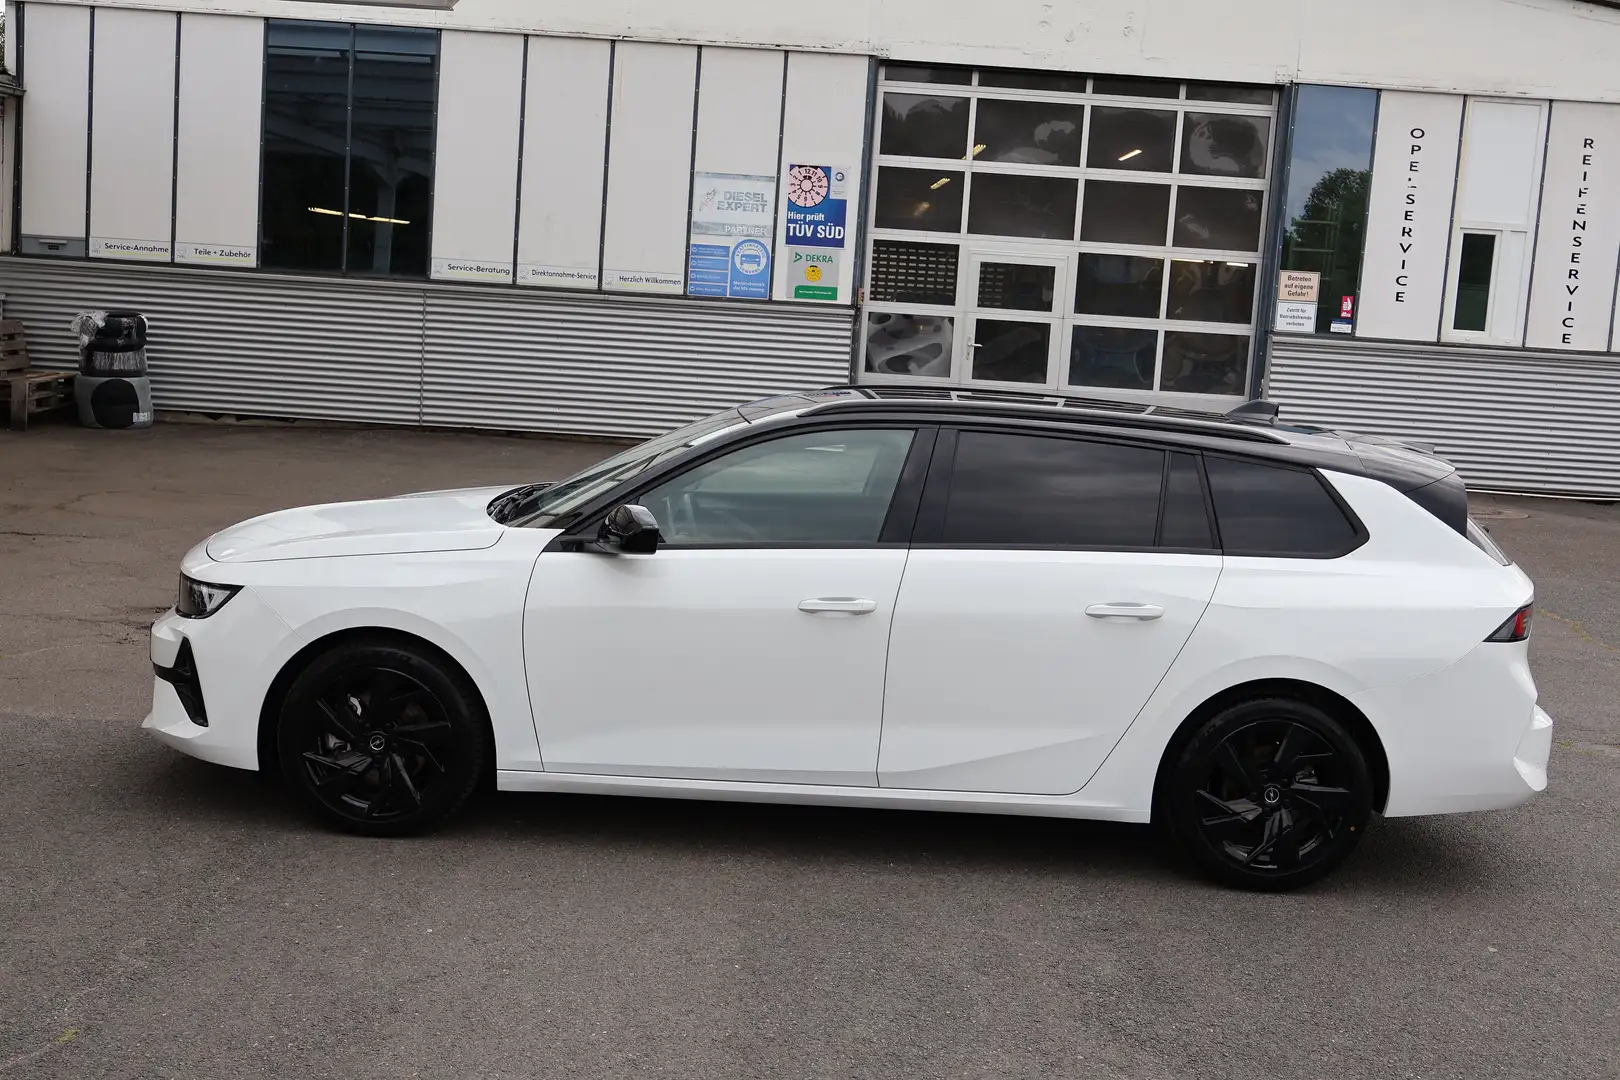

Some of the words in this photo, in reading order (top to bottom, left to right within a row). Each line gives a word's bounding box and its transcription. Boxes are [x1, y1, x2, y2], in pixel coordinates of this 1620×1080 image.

[724, 191, 768, 203] DIESEL
[716, 201, 768, 212] EXPERT
[788, 211, 804, 220] Hier
[806, 213, 824, 222] prüft
[725, 225, 766, 235] PARTNER
[788, 221, 814, 237] TÜV
[817, 223, 844, 239] SÜD
[1562, 138, 1594, 344] REIFENSERVICE
[104, 242, 169, 253] Service-Annahme
[220, 250, 251, 258] Zubehör
[805, 254, 833, 263] DEKRA
[448, 264, 510, 275] Service-Beratung
[532, 269, 596, 280] Direktannahme-Service
[645, 276, 681, 285] Willkommen
